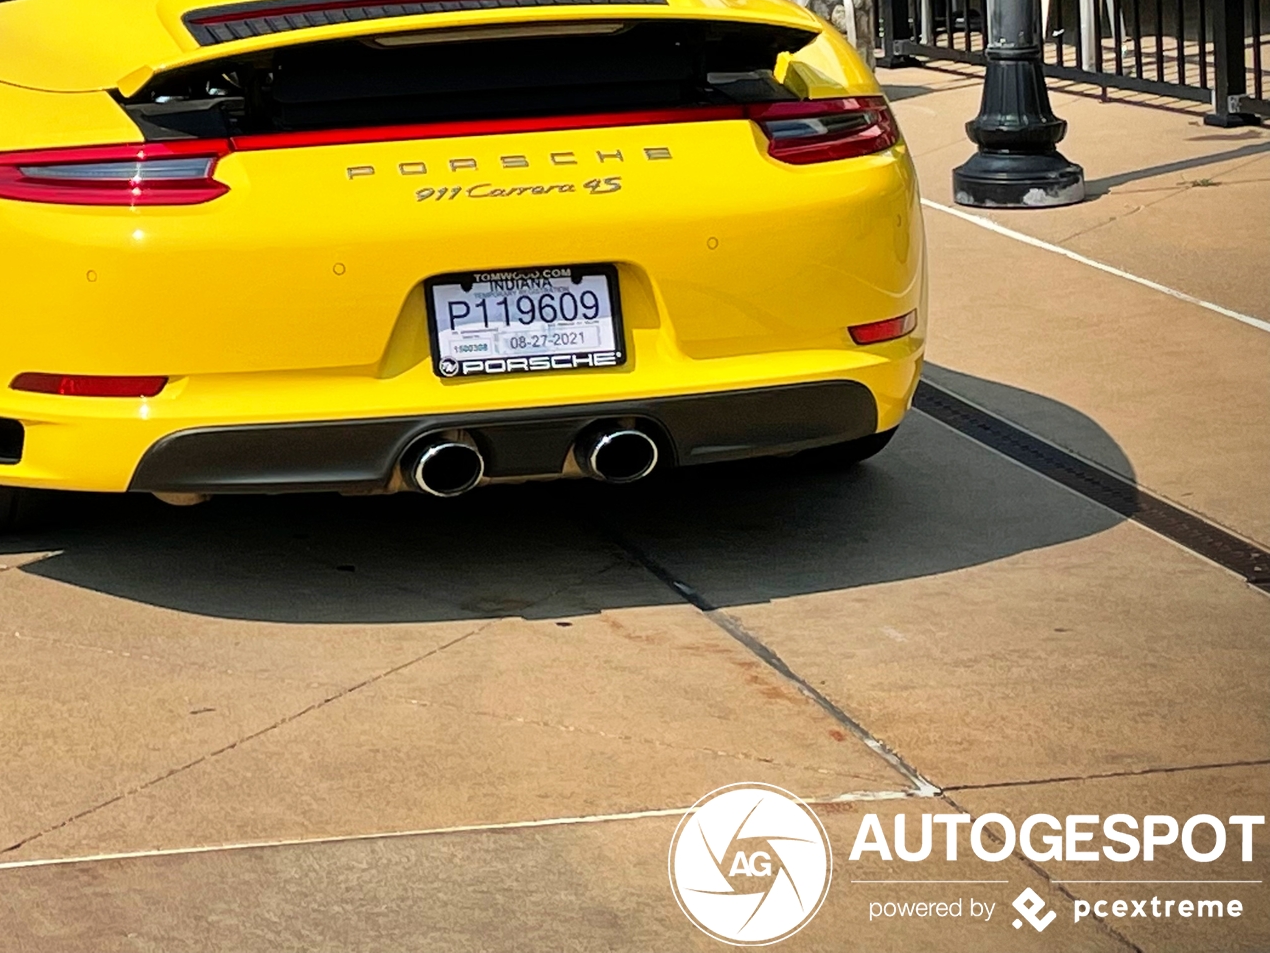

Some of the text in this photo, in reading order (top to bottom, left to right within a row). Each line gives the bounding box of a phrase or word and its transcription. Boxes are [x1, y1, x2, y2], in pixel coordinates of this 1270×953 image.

[347, 146, 673, 179] PORSCHE
[415, 176, 623, 202] 911 Carrera 4S
[489, 278, 552, 292] INDIANA
[447, 290, 600, 331] P119609
[510, 332, 585, 349] 08-27-2021
[462, 352, 617, 375] PORSCHE
